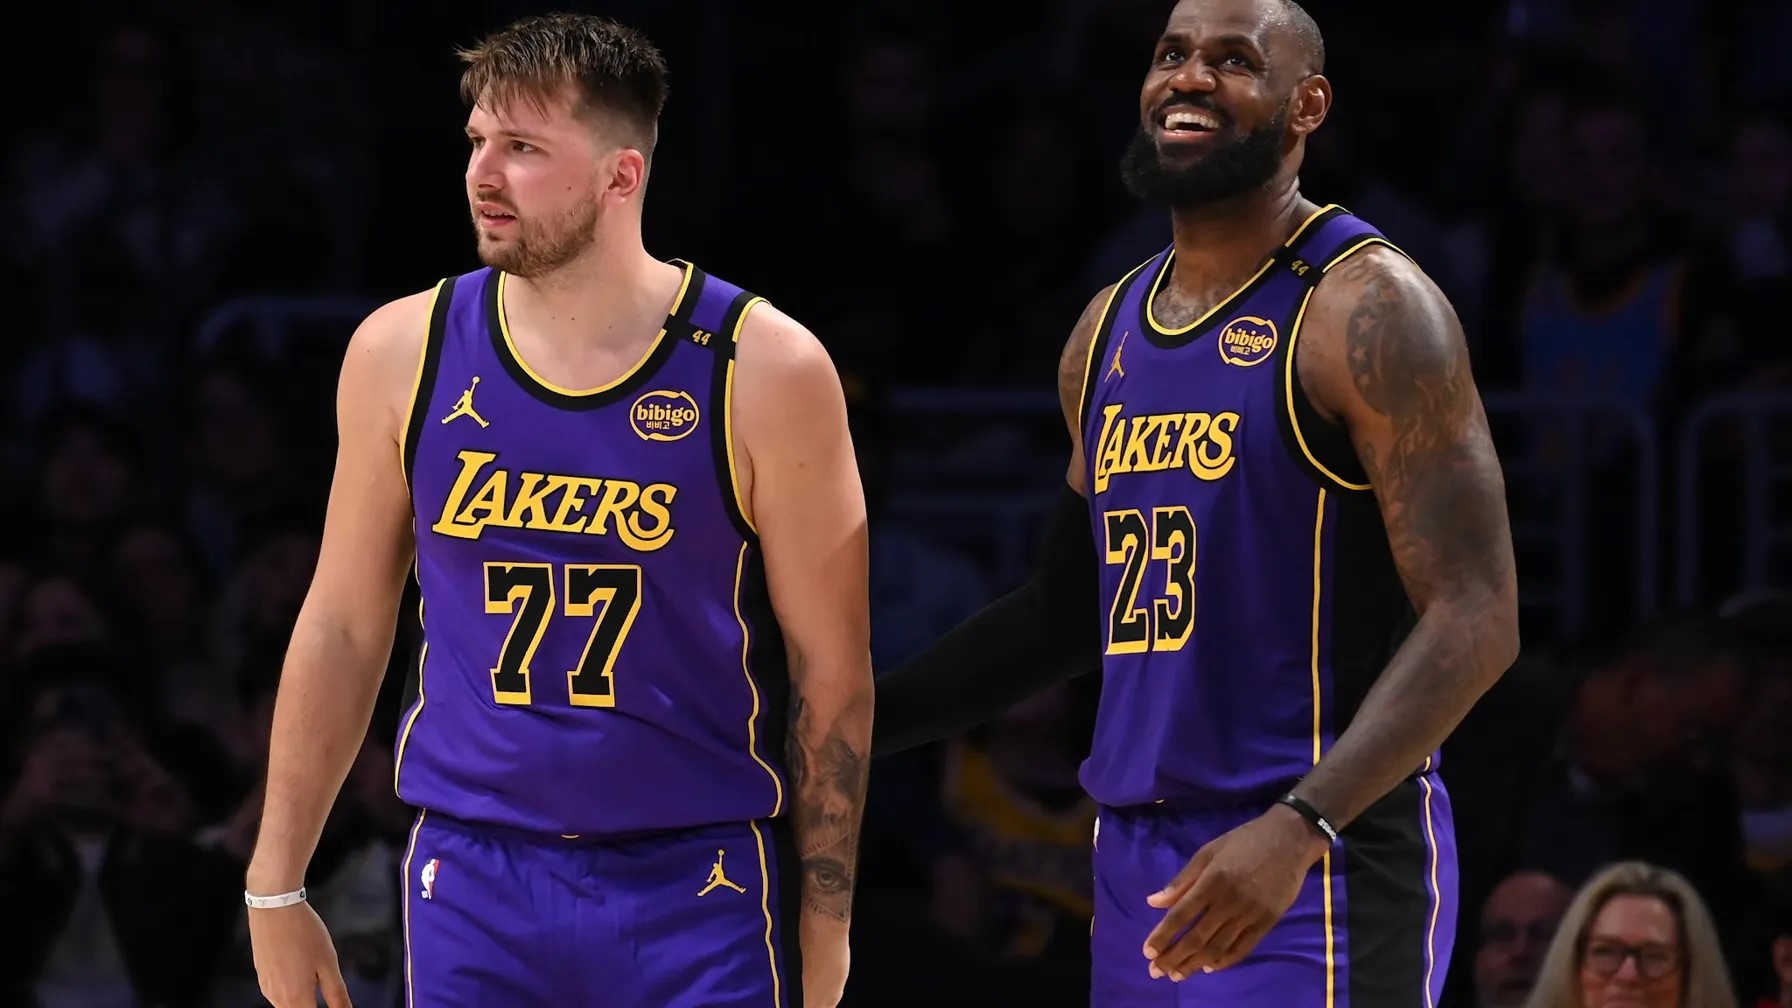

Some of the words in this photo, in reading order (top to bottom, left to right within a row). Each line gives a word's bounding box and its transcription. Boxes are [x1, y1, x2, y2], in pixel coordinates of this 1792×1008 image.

[1291, 260, 1310, 277] 44
[692, 329, 712, 346] 44
[1225, 327, 1273, 353] bibigo
[637, 403, 695, 427] bibigo
[1095, 403, 1240, 495] LAKERS
[432, 450, 678, 552] LAKERS
[1103, 505, 1197, 656] 23
[483, 561, 642, 708] 77
